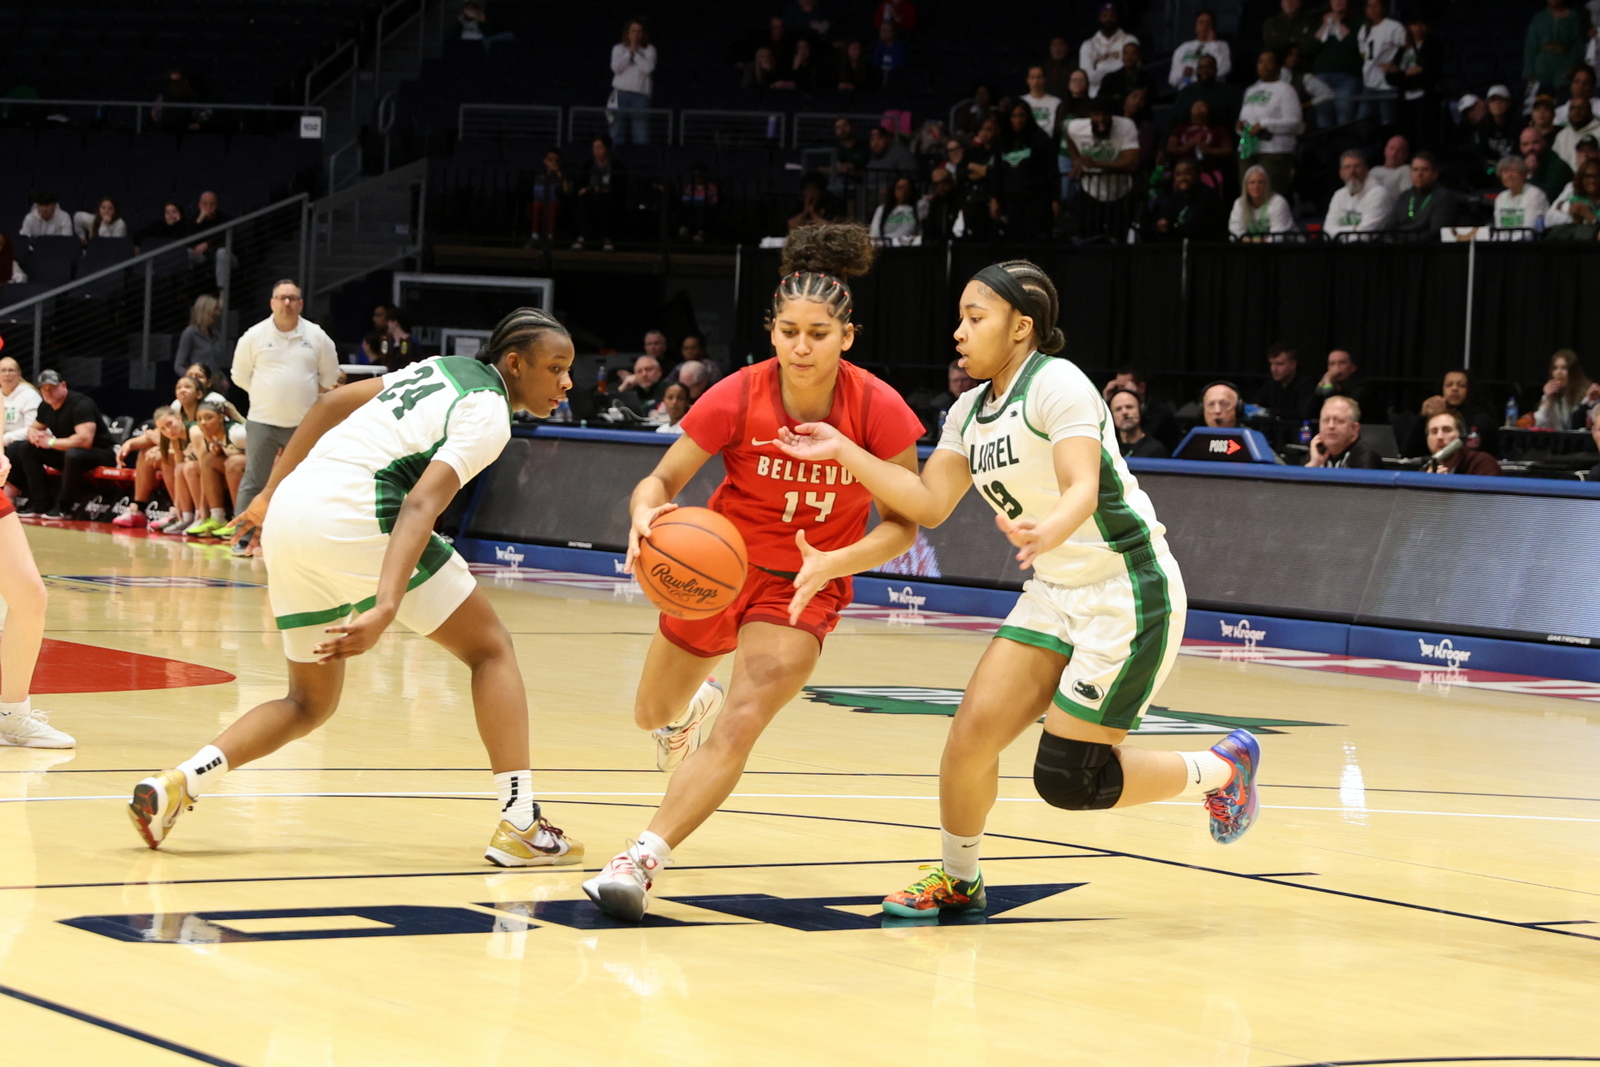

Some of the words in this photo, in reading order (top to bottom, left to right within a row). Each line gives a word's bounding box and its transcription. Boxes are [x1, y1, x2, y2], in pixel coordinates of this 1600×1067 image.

[376, 365, 447, 421] 24
[969, 434, 1020, 475] LAUREL
[1208, 439, 1229, 453] POSS
[757, 455, 860, 486] BELLEVU
[781, 491, 836, 523] 14
[982, 480, 1023, 520] 13
[651, 563, 719, 603] Rawlings
[1233, 619, 1266, 645] Kroger
[1434, 638, 1472, 666] Kroger
